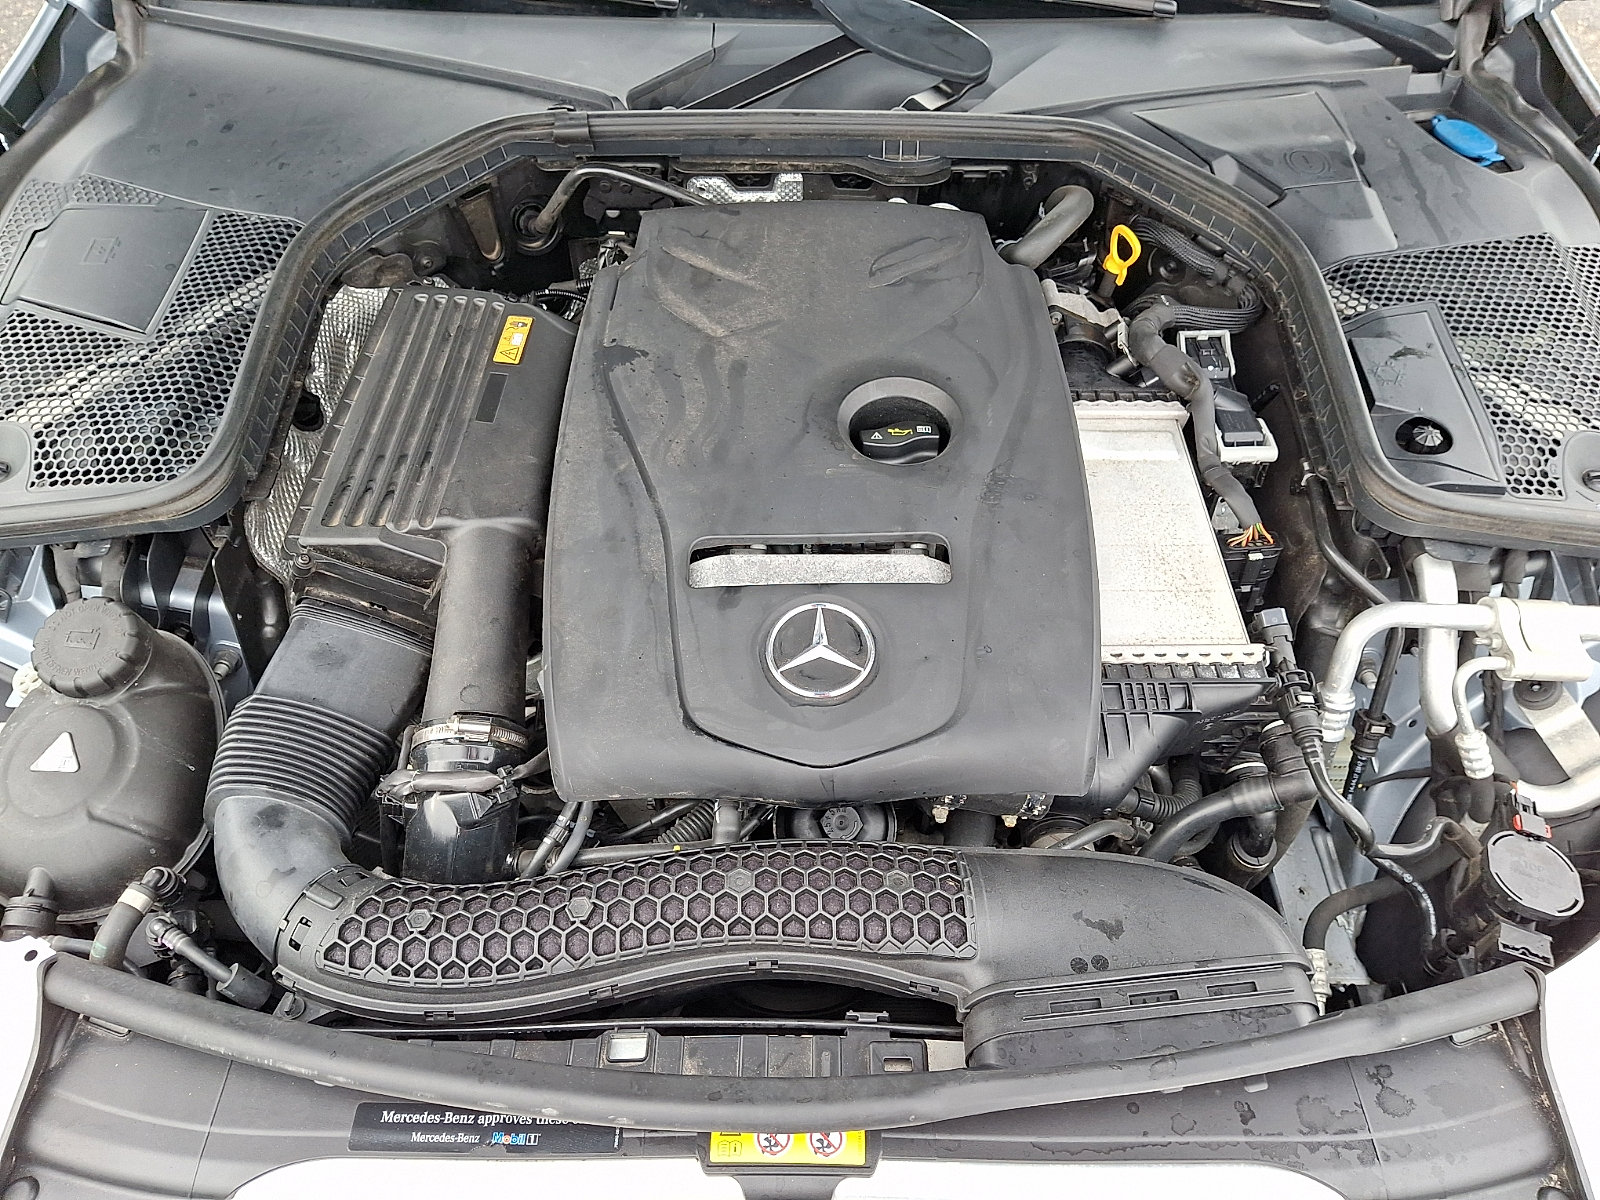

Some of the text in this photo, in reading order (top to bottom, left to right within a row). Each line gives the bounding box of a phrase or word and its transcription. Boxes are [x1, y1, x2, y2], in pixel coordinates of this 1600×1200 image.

[380, 1110, 475, 1124] Mercedes-Benz
[477, 1113, 533, 1127] approves
[410, 1131, 480, 1143] Mercedes-Benz
[492, 1131, 526, 1145] Mobil
